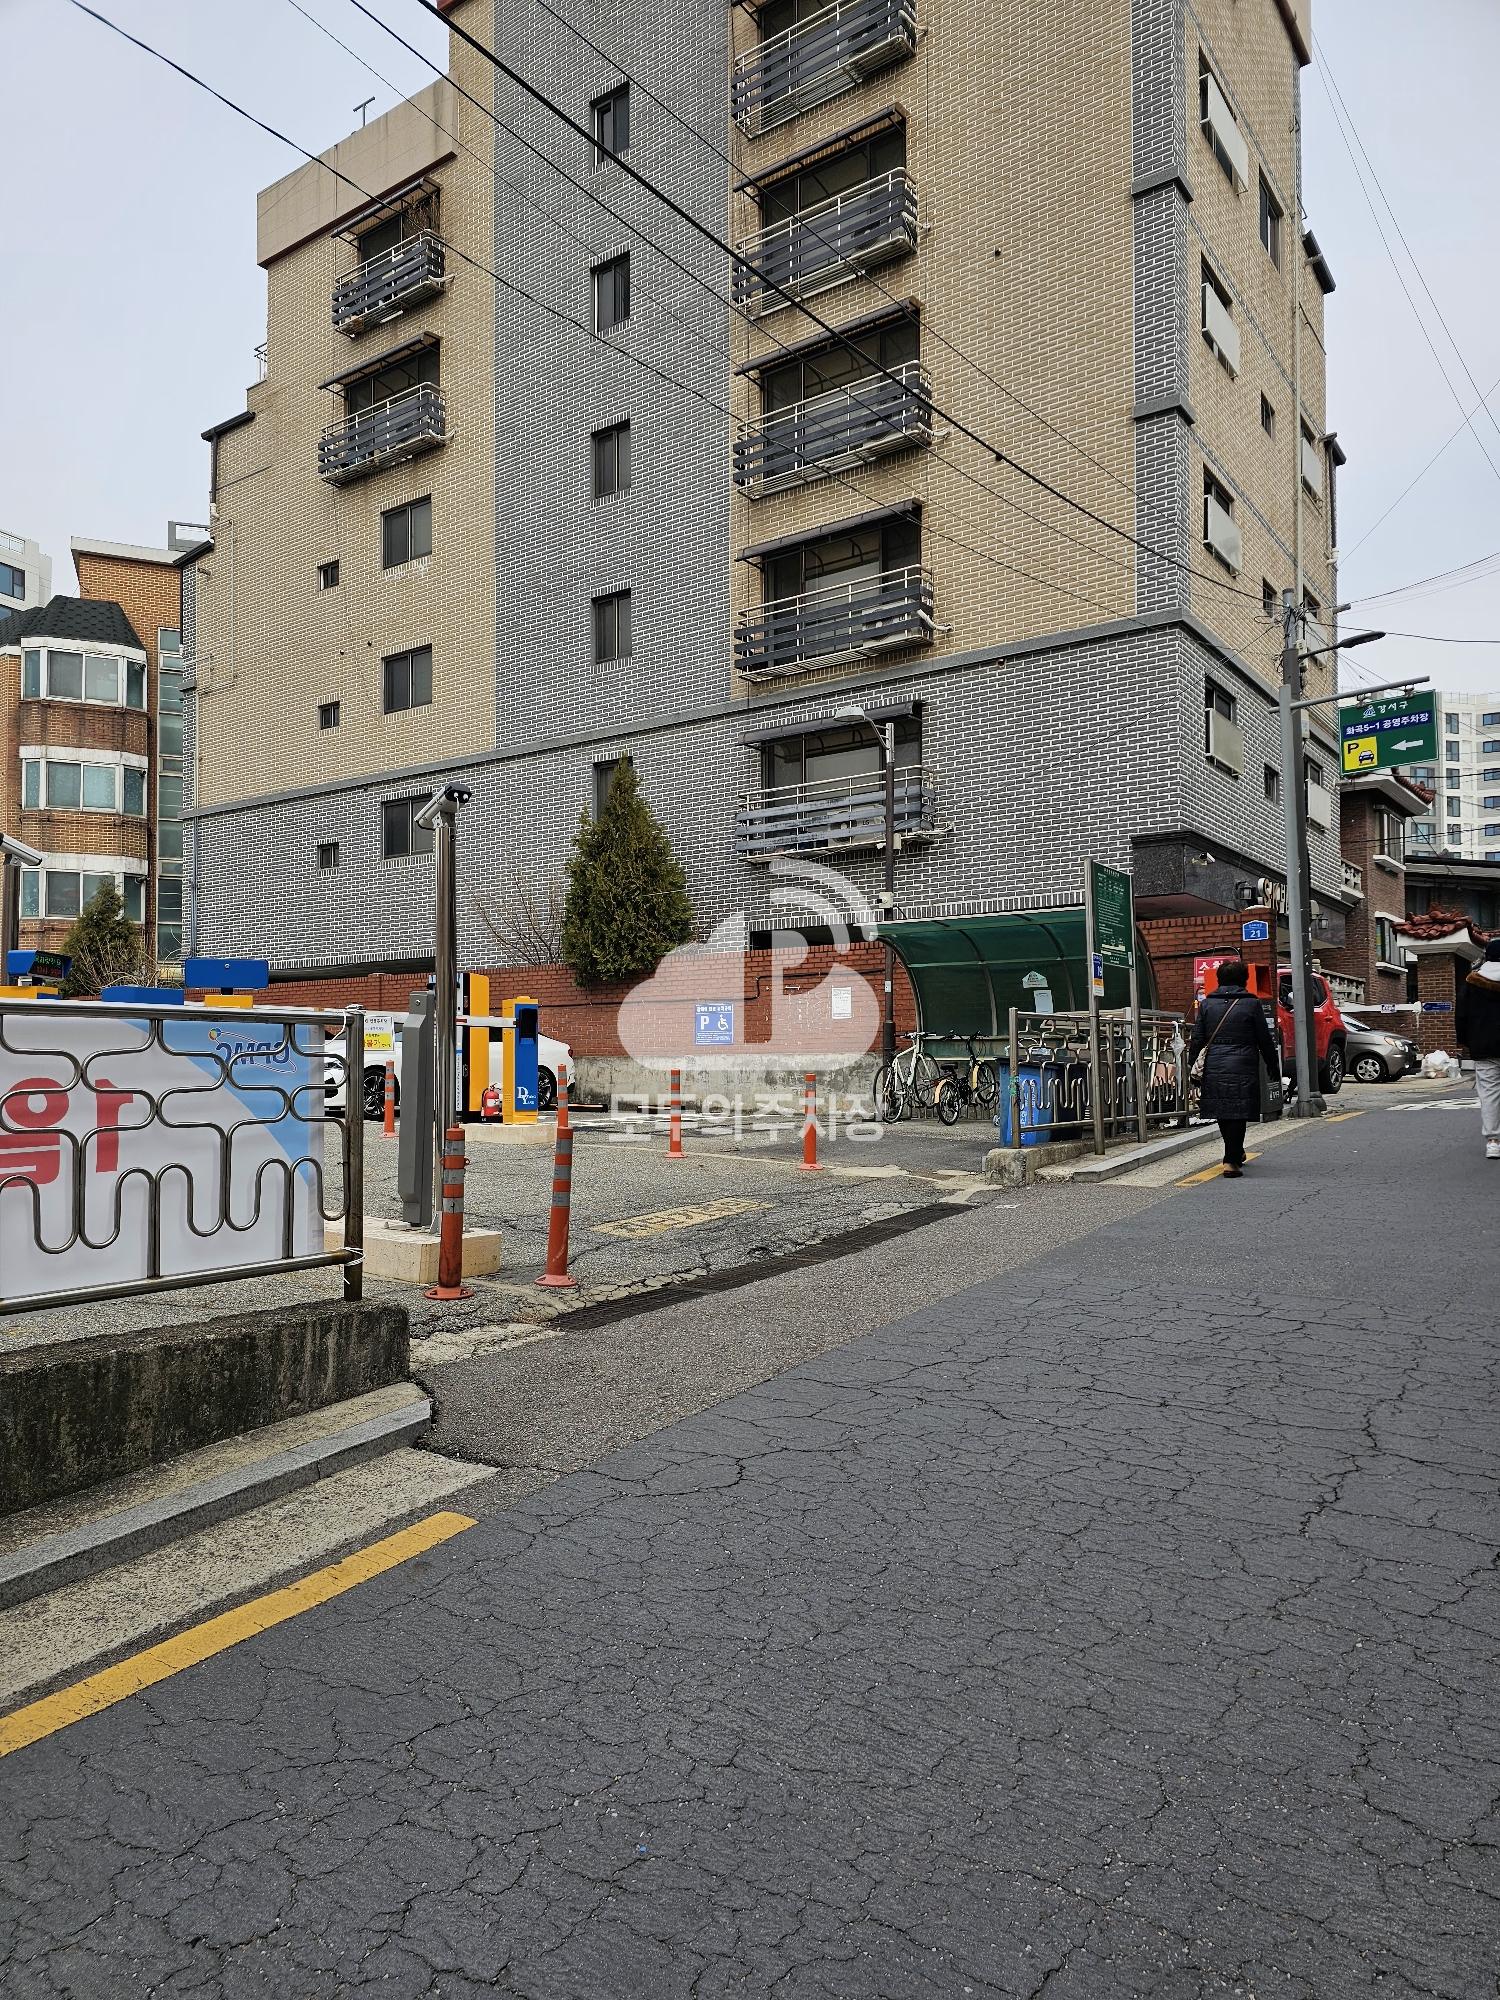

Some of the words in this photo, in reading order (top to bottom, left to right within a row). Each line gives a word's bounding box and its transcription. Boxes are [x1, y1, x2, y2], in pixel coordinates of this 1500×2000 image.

[1377, 700, 1408, 714] 강서구
[1346, 721, 1380, 735] 화곡5-1
[1383, 712, 1429, 729] 공영주차장
[1347, 743, 1359, 754] P
[1250, 930, 1261, 938] 21
[700, 1016, 709, 1030] P
